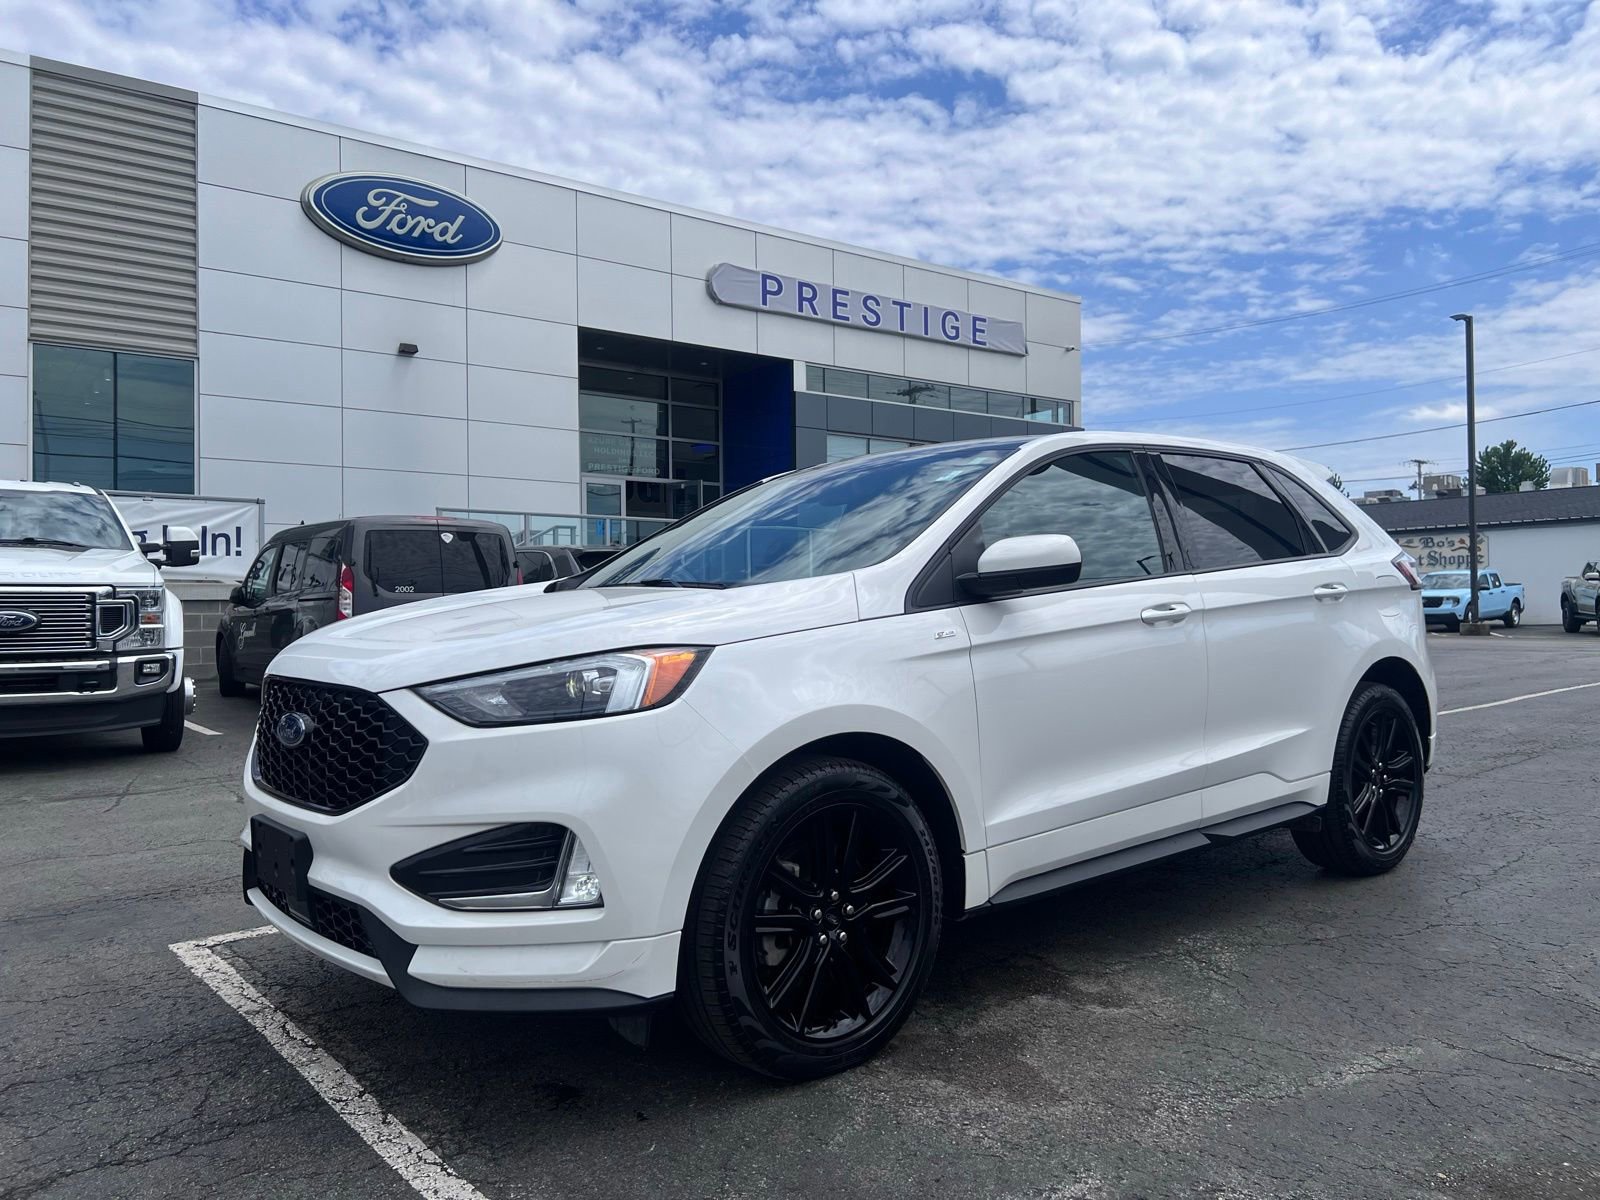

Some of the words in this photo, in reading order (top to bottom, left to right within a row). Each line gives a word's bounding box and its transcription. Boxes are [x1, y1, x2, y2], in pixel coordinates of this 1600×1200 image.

[355, 188, 466, 244] Ford
[760, 273, 988, 346] PRESTIGE
[201, 525, 242, 557] In!
[394, 585, 415, 593] 2002
